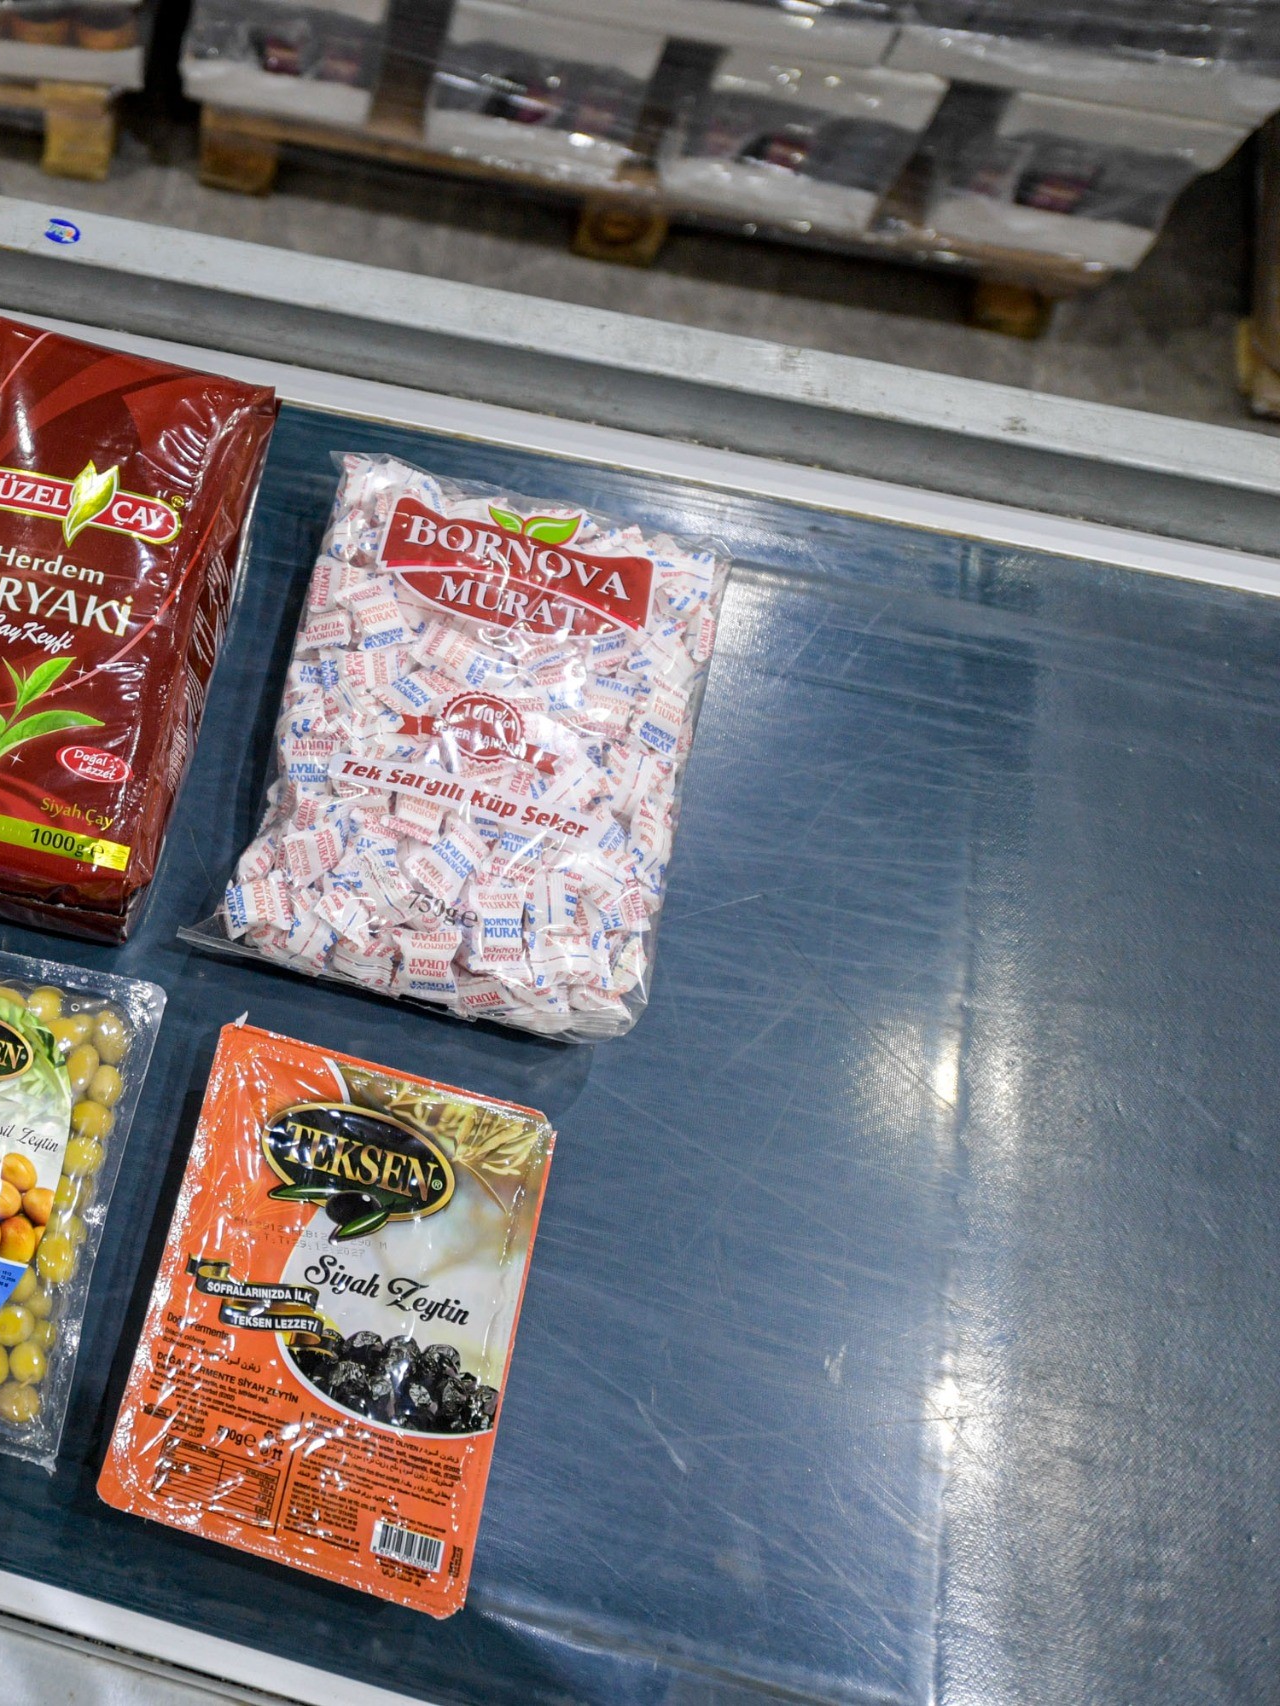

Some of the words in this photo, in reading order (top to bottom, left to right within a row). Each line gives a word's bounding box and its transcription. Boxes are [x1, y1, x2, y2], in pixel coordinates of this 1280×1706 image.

[111, 501, 167, 532] ÇAY
[404, 515, 631, 601] BORNOVA
[436, 575, 585, 633] MURAT
[21, 622, 75, 654] Keyfi
[463, 703, 513, 730] 100%
[639, 729, 672, 754] MURAT
[643, 721, 676, 746] BORNOVA
[74, 749, 108, 767] Doğal
[78, 762, 118, 781] Lezzet
[341, 760, 381, 781] Tek
[386, 768, 466, 802] Sargılı
[470, 789, 517, 818] Küp
[521, 806, 589, 840] Şeker
[40, 797, 81, 819] Siyah
[85, 809, 114, 831] Çay
[411, 932, 457, 942] MURAT
[484, 928, 523, 938] MURAT
[17, 1127, 59, 1153] Zeytin
[284, 1121, 438, 1201] TEKSEN
[206, 1281, 292, 1300] SOFRALARINIZDA
[294, 1286, 312, 1304] İLK
[304, 1254, 380, 1299] Siyah
[386, 1277, 471, 1326] Zeytin
[232, 1313, 272, 1329] TEKSEN
[274, 1317, 318, 1332] LEZZETİ
[238, 1378, 265, 1392] SİYAH
[266, 1387, 299, 1403] ZEYTİN
